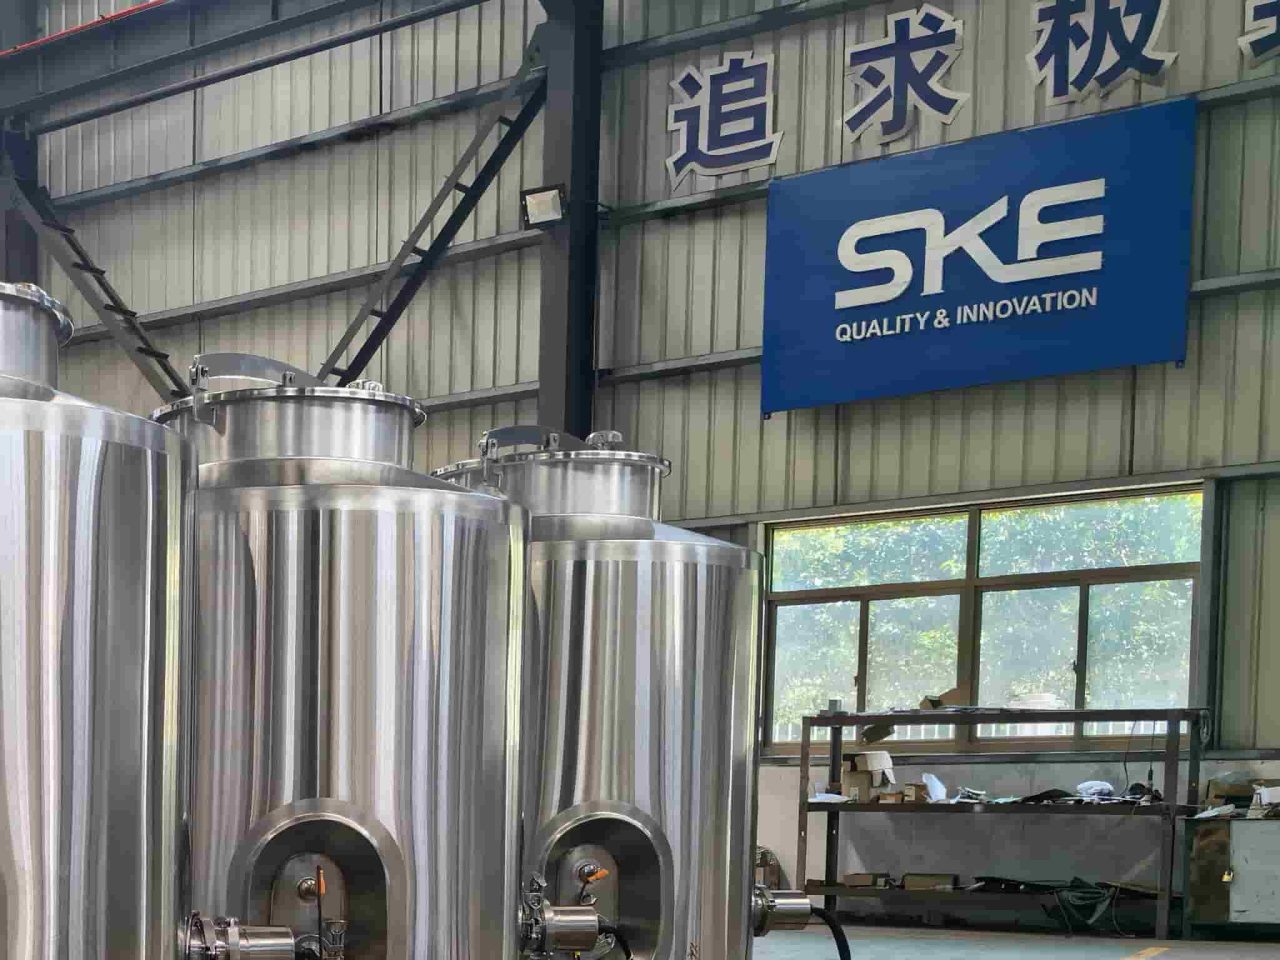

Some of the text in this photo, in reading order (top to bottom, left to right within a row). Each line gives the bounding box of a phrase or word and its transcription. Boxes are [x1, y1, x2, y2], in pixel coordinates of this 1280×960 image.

[666, 0, 1280, 178] 追求极
[835, 178, 1105, 310] SKE
[835, 287, 1098, 342] QUALITY & INNOVATION
